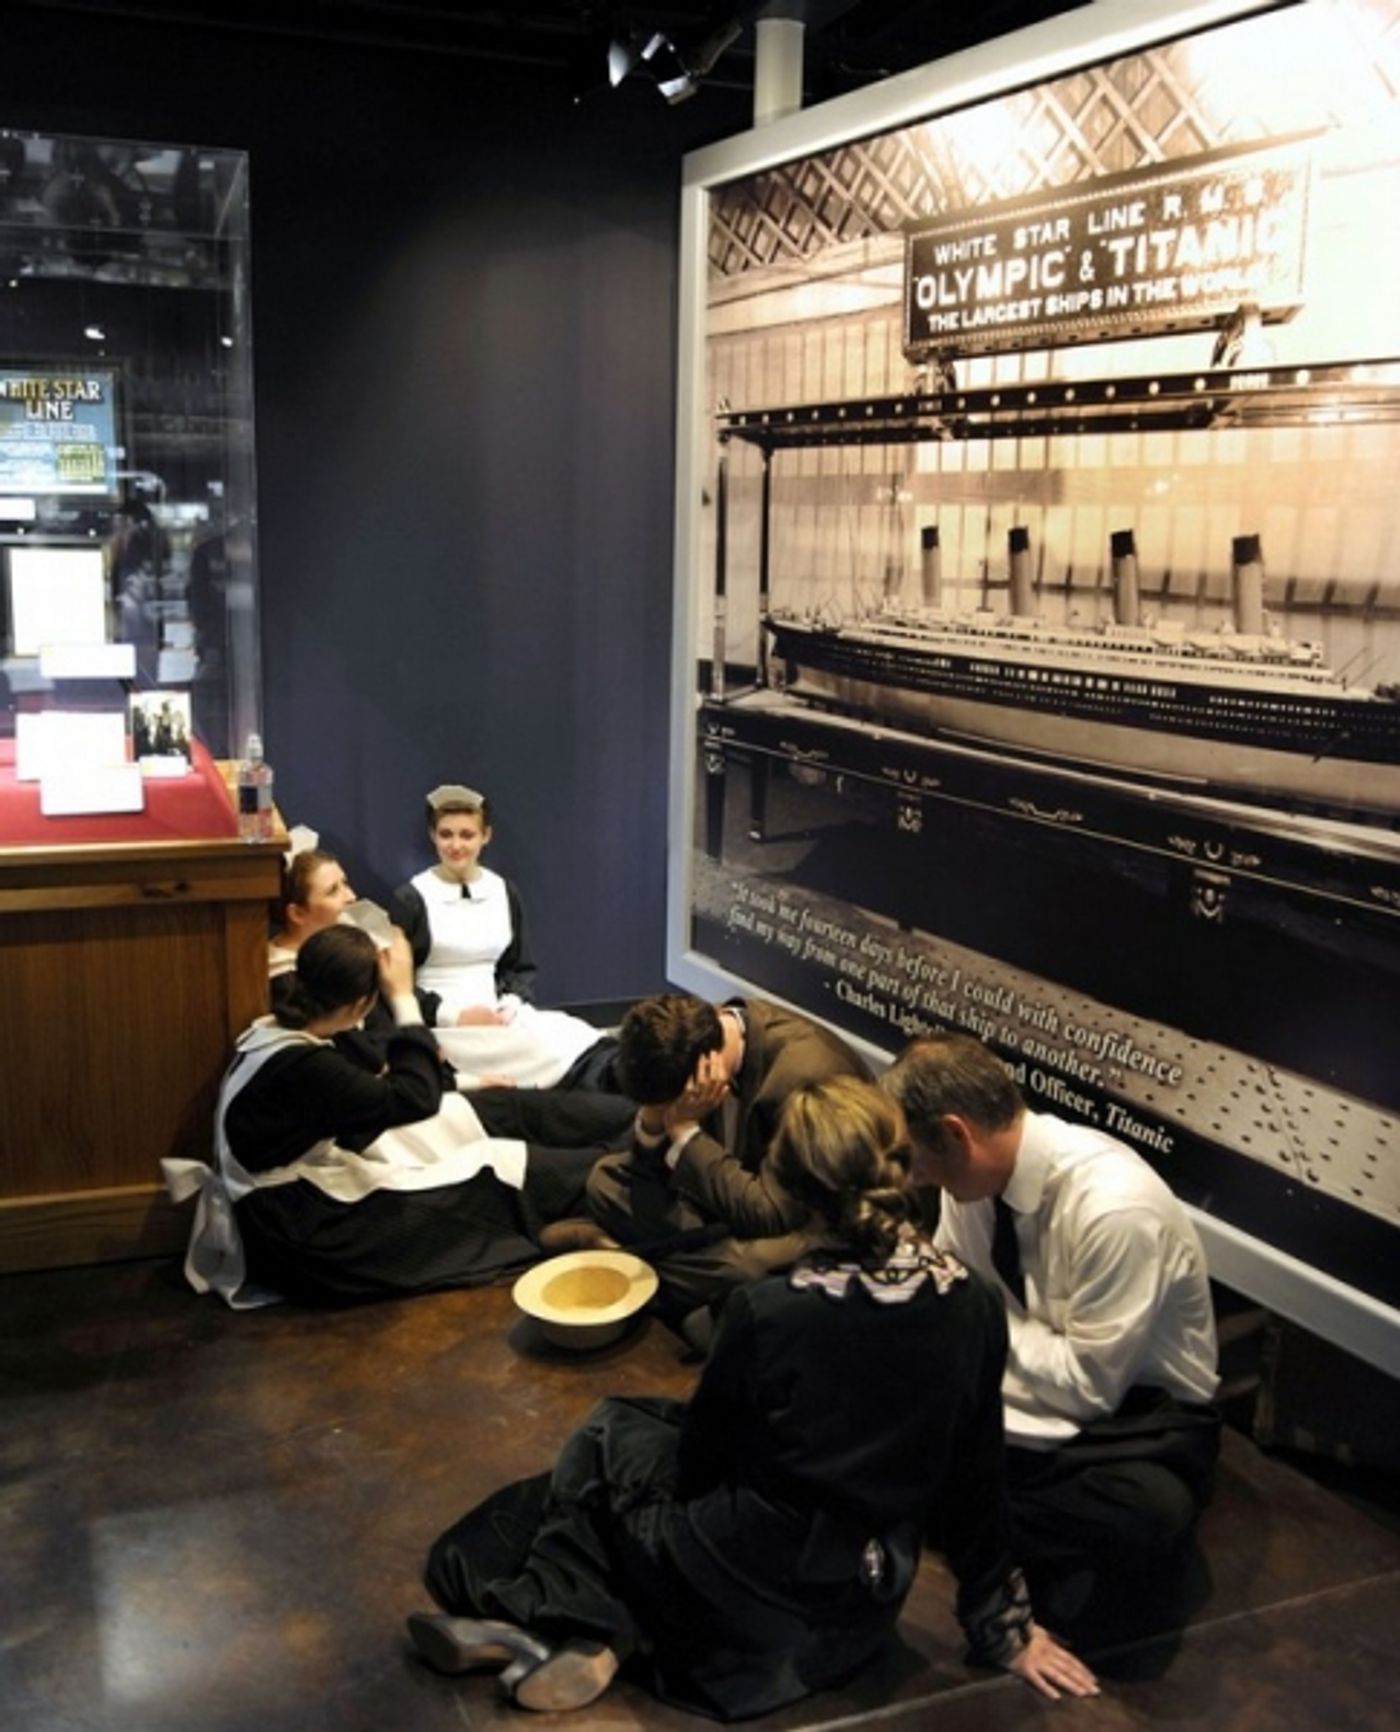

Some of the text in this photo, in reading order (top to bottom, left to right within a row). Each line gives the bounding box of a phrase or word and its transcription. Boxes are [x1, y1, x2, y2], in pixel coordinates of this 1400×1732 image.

[934, 233, 997, 266] WHITE
[1013, 217, 1070, 249] STAR
[1088, 201, 1146, 234] LINE
[1079, 250, 1096, 282] &
[928, 311, 960, 333] THE
[961, 297, 1042, 328] LARGEST
[1044, 287, 1103, 316] SHIPS
[1106, 285, 1128, 307] IN
[1132, 277, 1177, 303] THE
[26, 400, 74, 420] LINE
[53, 379, 101, 401] STAR
[799, 906, 857, 949] fourteen
[859, 932, 892, 966] days
[897, 948, 948, 987] before
[964, 980, 1014, 1014] could
[1018, 1001, 1059, 1034] with
[1064, 1024, 1183, 1085] confidence
[838, 957, 868, 980] one
[866, 970, 899, 996] part
[902, 982, 921, 1009] of
[922, 991, 955, 1021] that
[959, 1007, 997, 1043] ship
[999, 1026, 1018, 1048] to
[836, 978, 886, 1019] Charles
[1030, 1069, 1100, 1123] Officer,
[1106, 1102, 1175, 1155] Titanic
